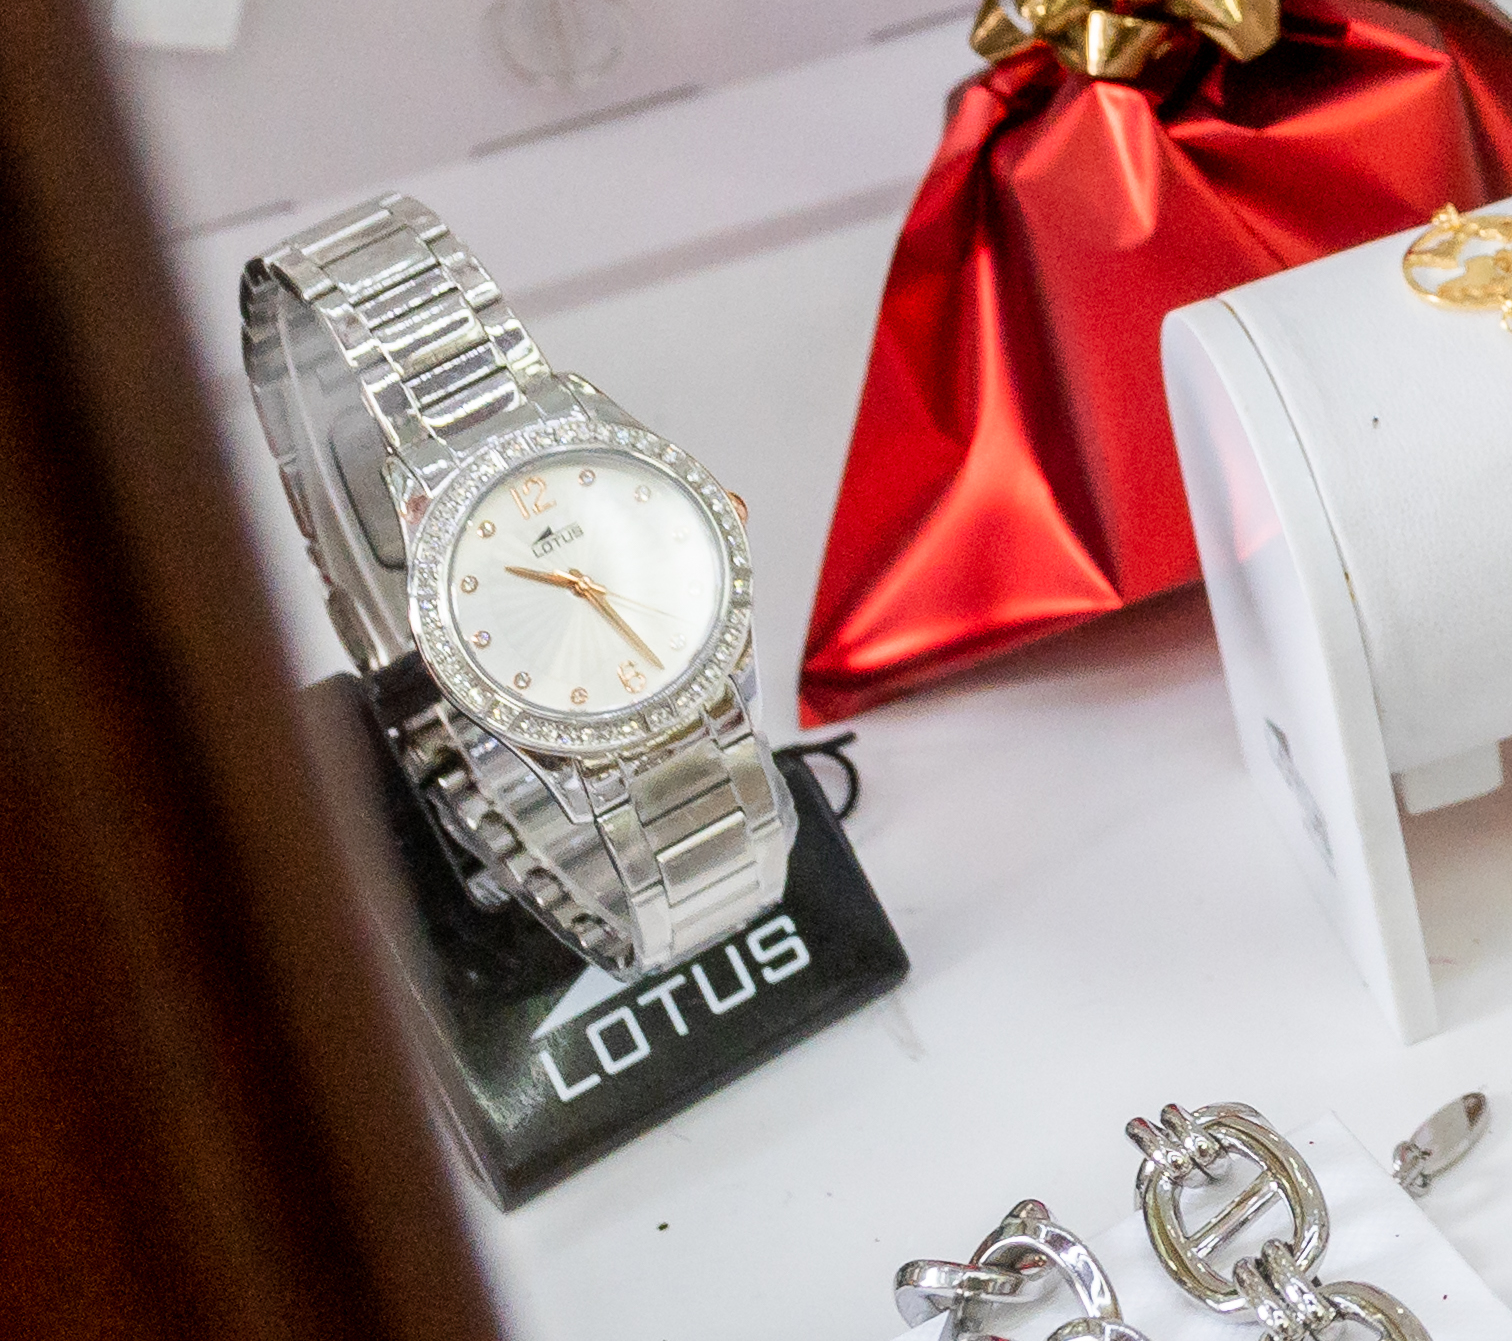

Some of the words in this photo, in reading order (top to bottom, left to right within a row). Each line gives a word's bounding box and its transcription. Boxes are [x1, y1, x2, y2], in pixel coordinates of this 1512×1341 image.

[509, 474, 558, 521] 12
[530, 522, 585, 560] LOTUS
[538, 914, 811, 1104] LOTUS
